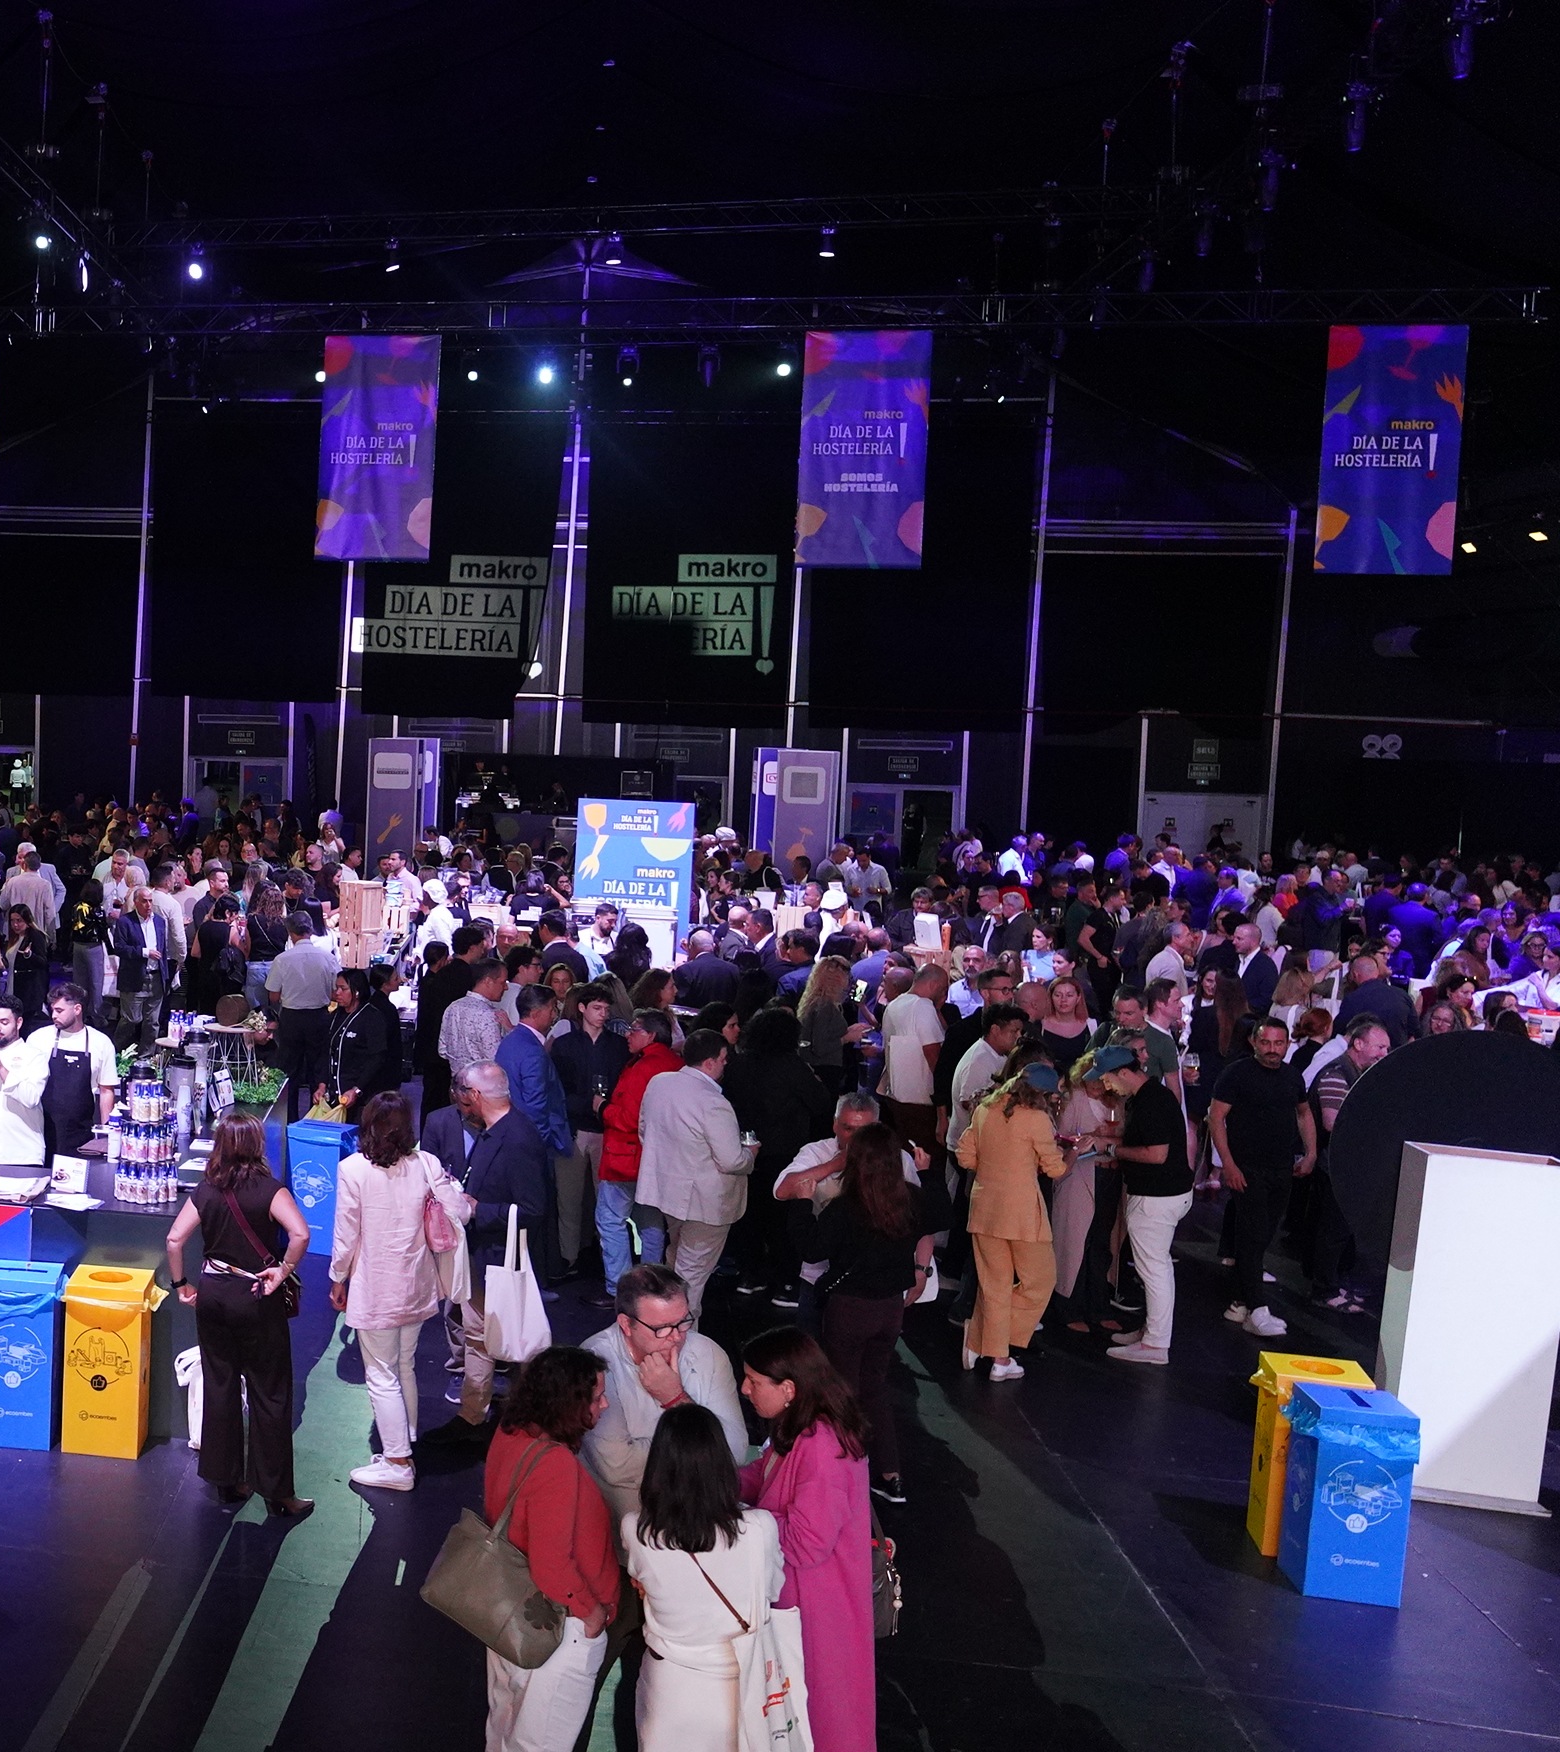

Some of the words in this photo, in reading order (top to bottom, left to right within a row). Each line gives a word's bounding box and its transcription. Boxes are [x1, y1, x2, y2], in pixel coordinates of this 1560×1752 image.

[864, 410, 904, 419] makro
[377, 422, 414, 431] makro
[829, 424, 852, 438] DÍA
[856, 426, 873, 438] DE
[876, 426, 894, 438] LA
[1391, 420, 1434, 430] makro
[346, 434, 366, 448] DÍA
[369, 437, 385, 448] DE
[388, 437, 404, 448] LA
[813, 441, 893, 455] HOSTELERÍA
[1352, 435, 1378, 450] DÍA
[1381, 436, 1400, 449] DE
[1403, 437, 1423, 450] LA
[330, 452, 403, 464] HOSTELERÍA
[1334, 453, 1422, 468] HOSTELERÍA
[840, 473, 883, 482] SOMOS
[824, 482, 899, 492] HOSTELERÍA
[459, 560, 538, 580] makro
[687, 558, 768, 577] makro
[389, 587, 433, 615] DÍA
[441, 592, 474, 616] DE
[482, 594, 516, 618] LA
[618, 588, 662, 616] DÍA
[672, 592, 704, 615] DE
[712, 592, 747, 615] LA
[358, 625, 514, 653] HOSTELERÍA
[621, 815, 633, 823] DÍA
[643, 816, 653, 824] LA
[613, 823, 653, 832] HOSTELERÍA
[636, 867, 676, 879] makro
[603, 880, 627, 895] DÍA
[628, 881, 646, 896] DE
[648, 883, 666, 897] LA
[1344, 1558, 1380, 1568] ecoembes
